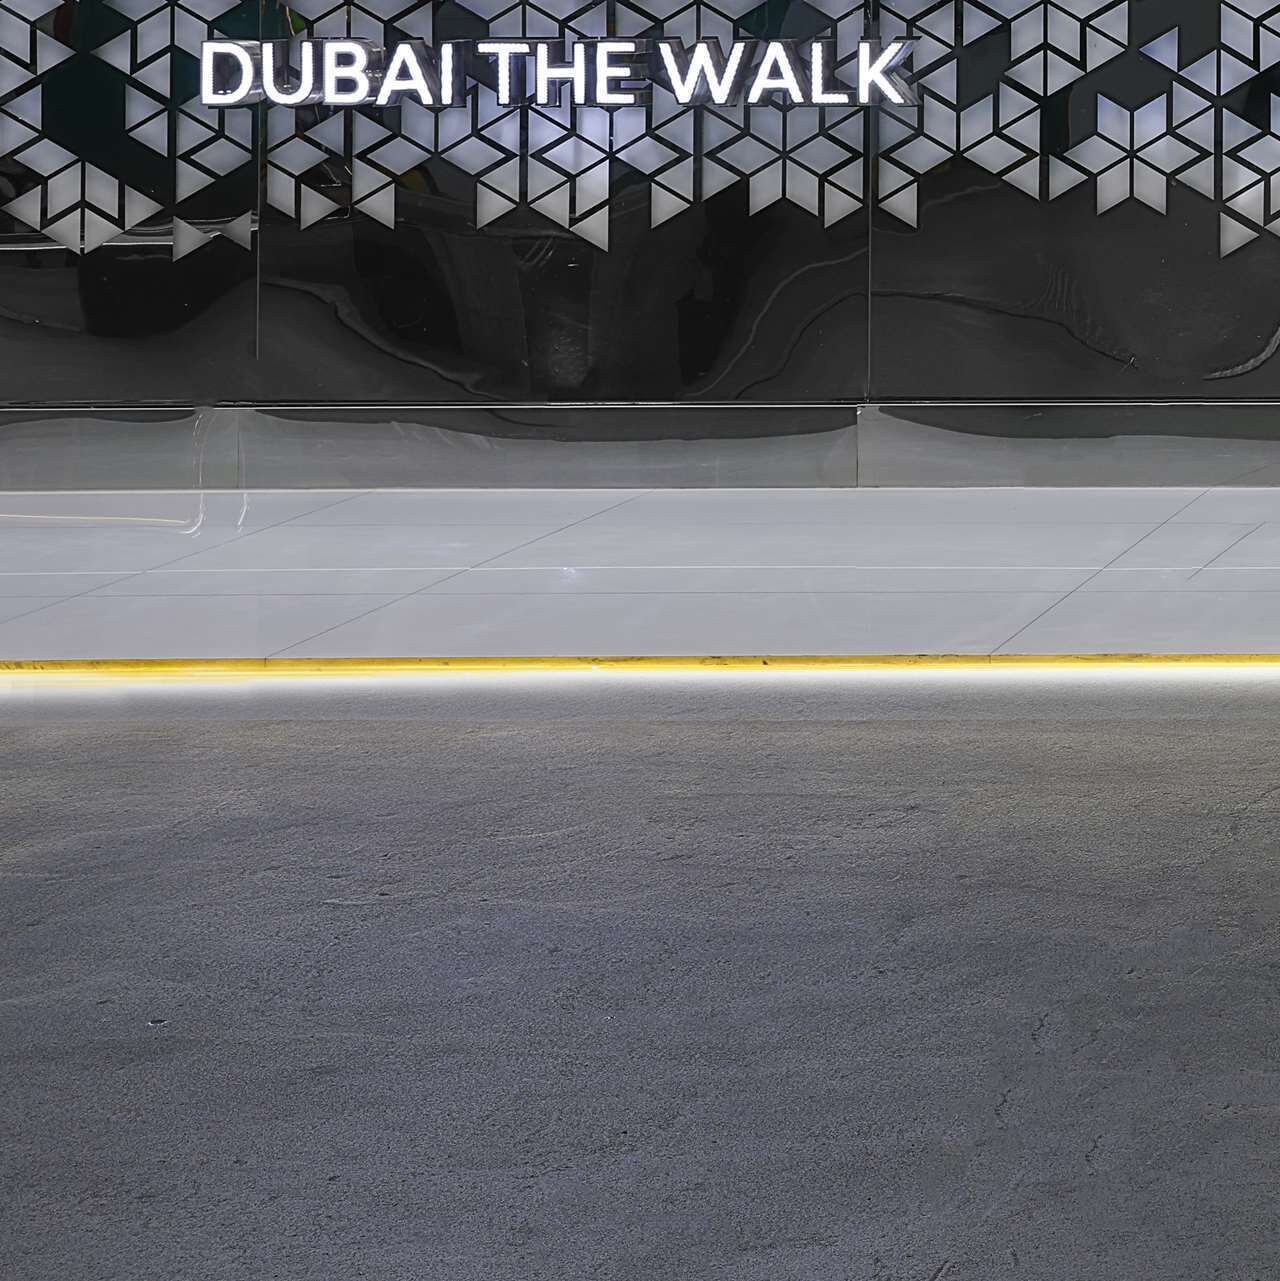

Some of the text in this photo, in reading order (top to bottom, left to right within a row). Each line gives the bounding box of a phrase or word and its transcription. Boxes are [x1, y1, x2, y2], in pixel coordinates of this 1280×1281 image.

[199, 39, 910, 106] DUBAI THE WALK
